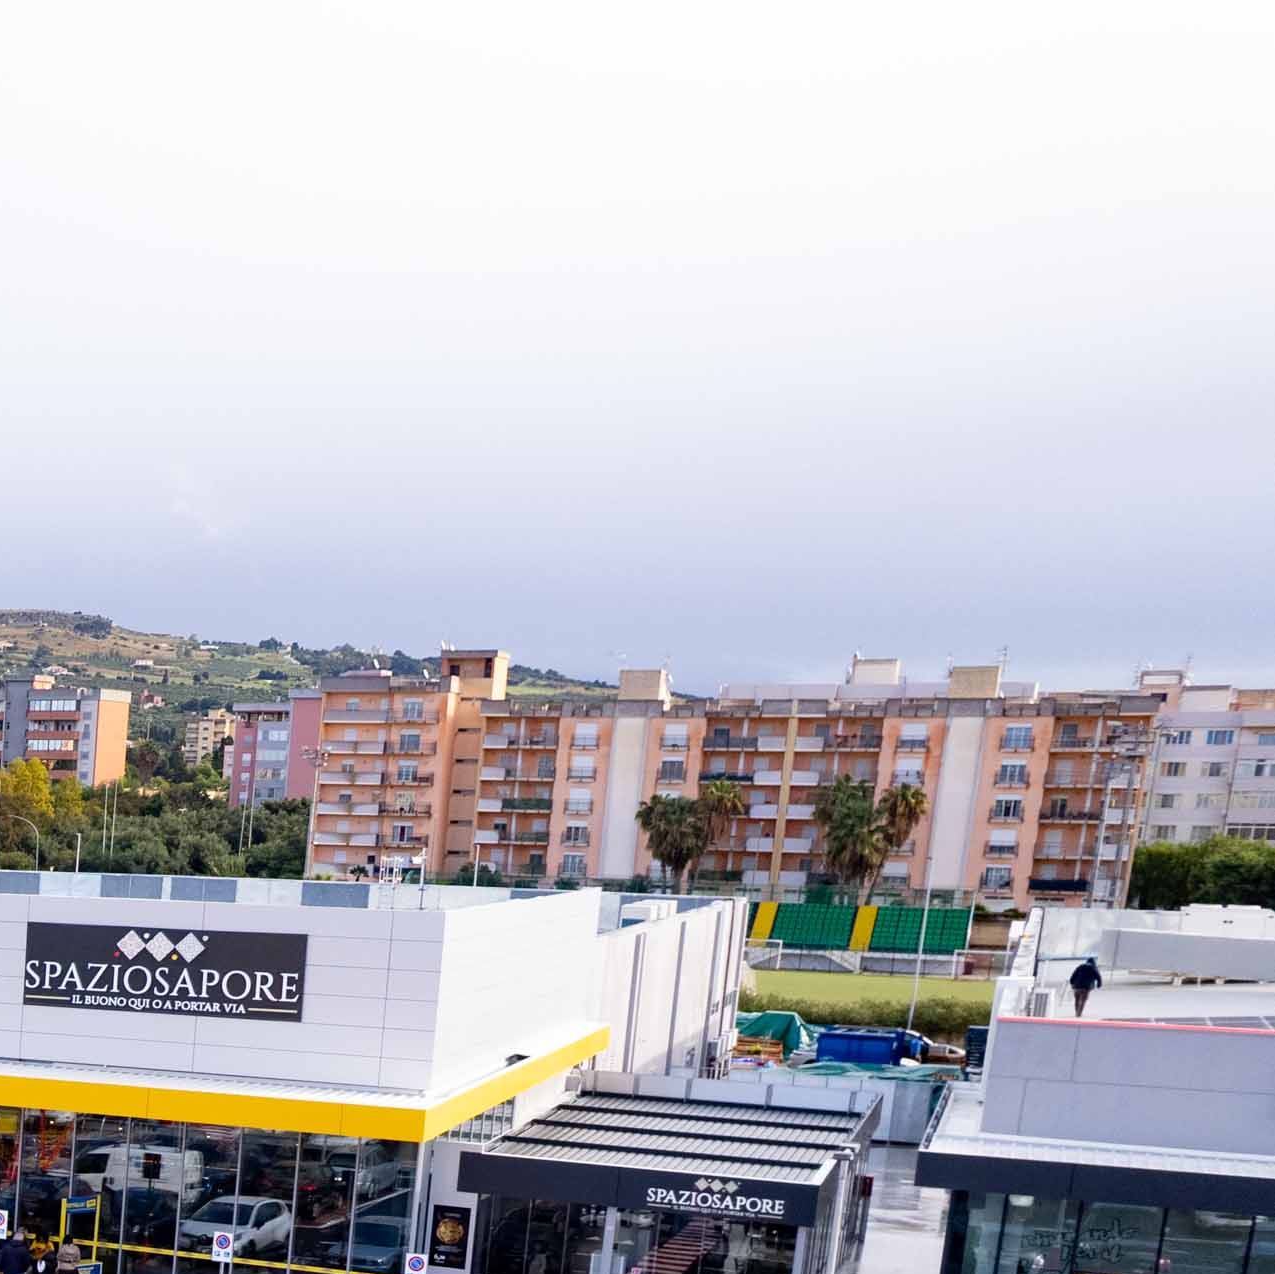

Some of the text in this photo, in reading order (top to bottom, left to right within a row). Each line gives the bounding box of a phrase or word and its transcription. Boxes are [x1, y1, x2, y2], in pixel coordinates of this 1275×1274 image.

[25, 960, 300, 1003] SPAZIOSAPORE
[72, 994, 247, 1014] IL BUONO QUI O A PORTAR VIA
[646, 1187, 786, 1215] SPAZIOSAPORE
